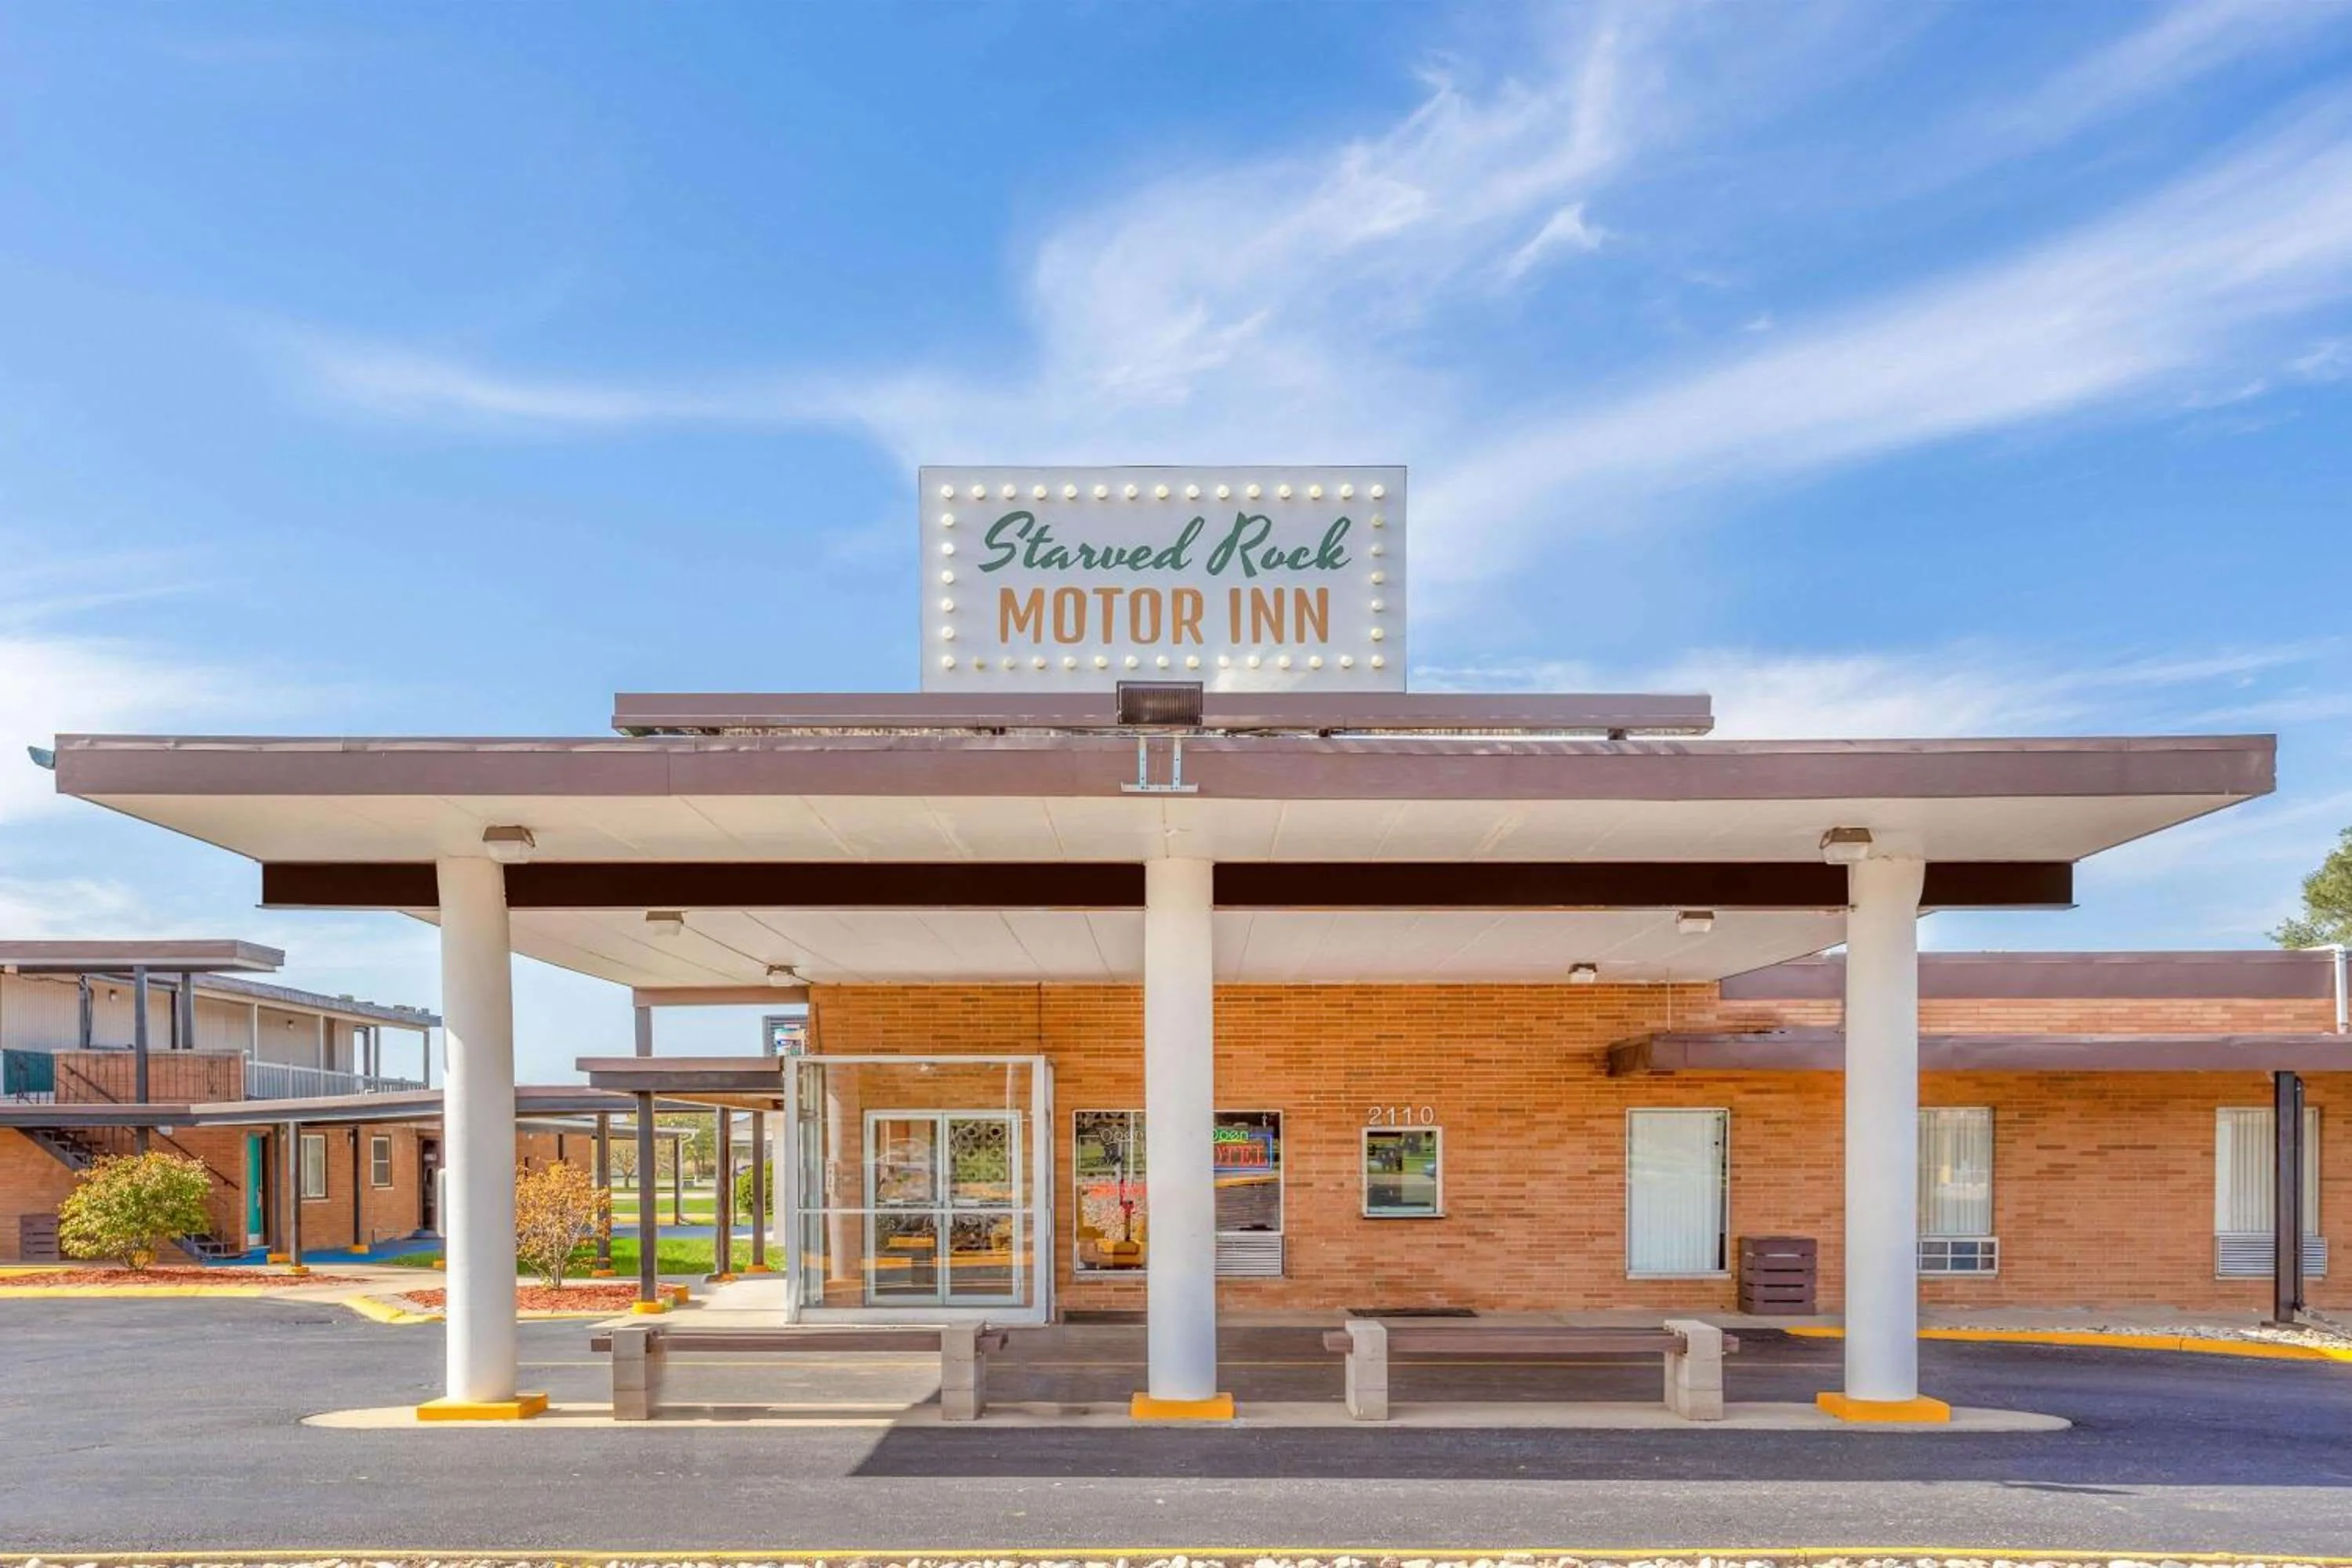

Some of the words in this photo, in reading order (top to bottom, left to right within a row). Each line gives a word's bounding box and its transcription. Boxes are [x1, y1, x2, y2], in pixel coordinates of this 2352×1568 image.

[978, 511, 1205, 573] Starved
[1207, 511, 1352, 578] Rock
[1000, 587, 1203, 644] MOTOR
[1230, 588, 1328, 644] INN
[1368, 1106, 1434, 1125] 2110
